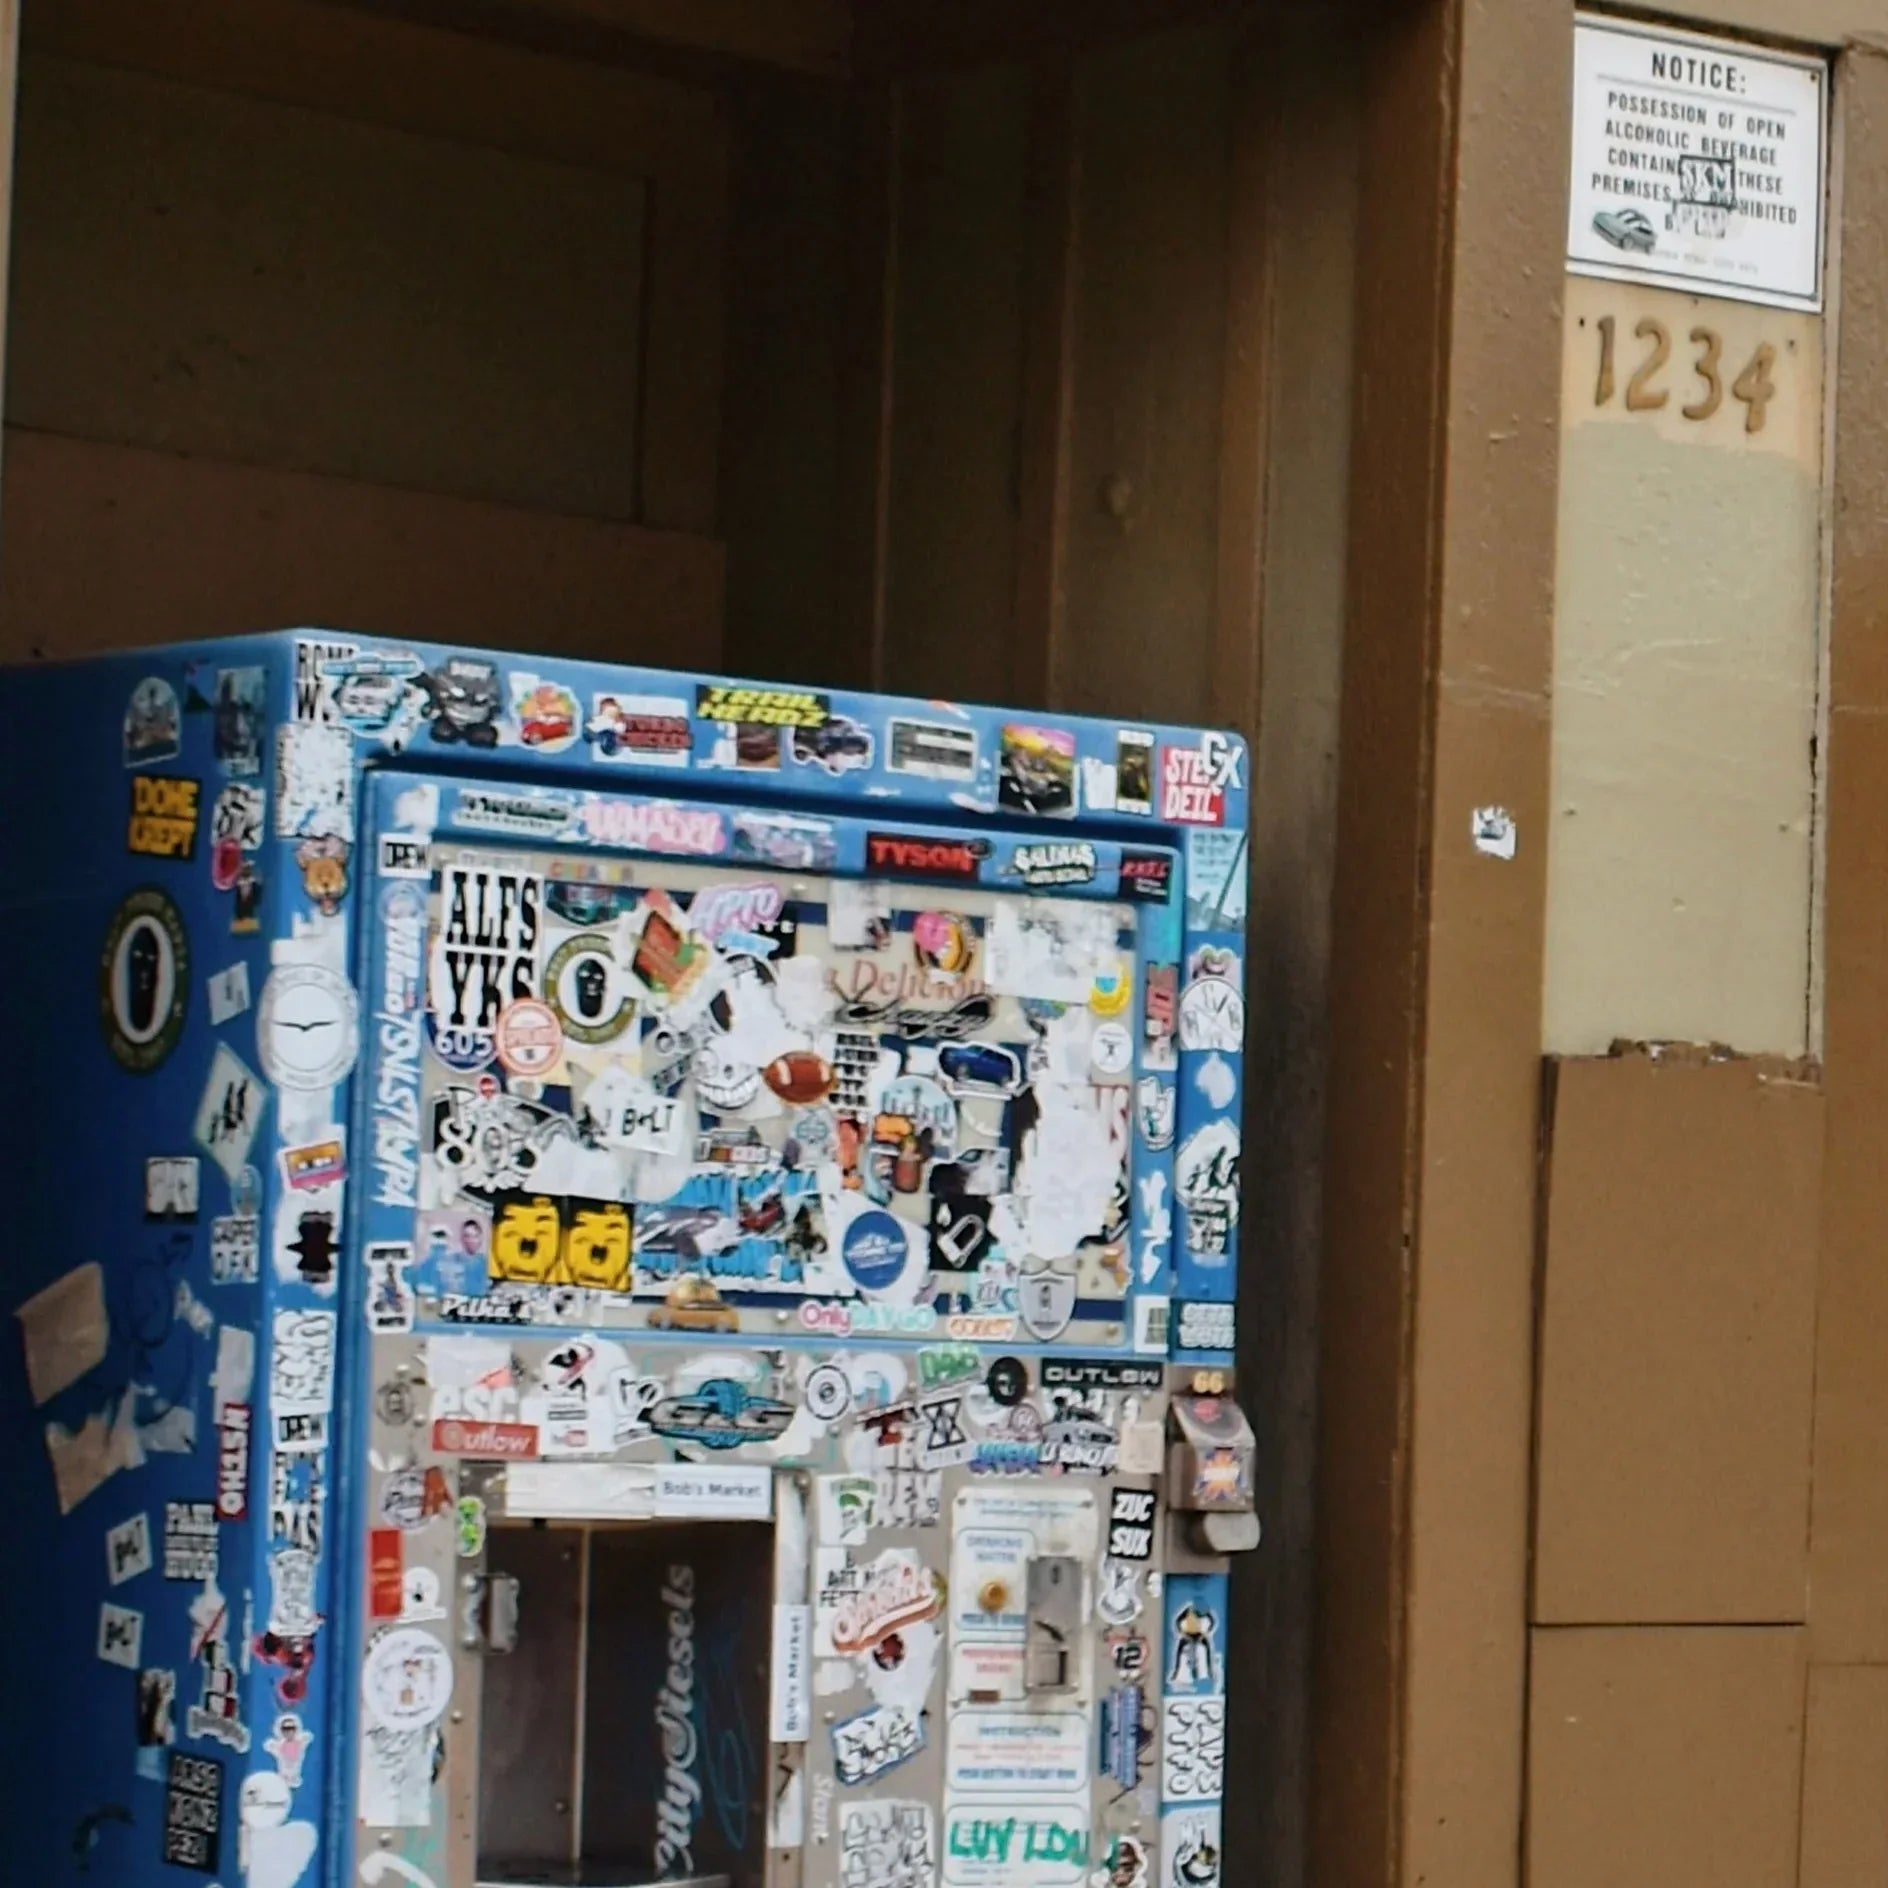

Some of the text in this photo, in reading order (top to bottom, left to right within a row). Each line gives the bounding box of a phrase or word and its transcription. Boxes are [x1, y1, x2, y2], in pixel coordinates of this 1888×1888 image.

[1651, 52, 1747, 94] NOTICE:
[1608, 90, 1786, 139] POSSESSION OF OPEN
[1605, 119, 1777, 166] ALCOHOLIC BEVERAGE
[1591, 174, 1672, 204] PREMISES
[1739, 171, 1783, 196] THESE
[1595, 315, 1776, 434] 1234
[870, 840, 974, 873] TYSON
[435, 1031, 493, 1055] 605
